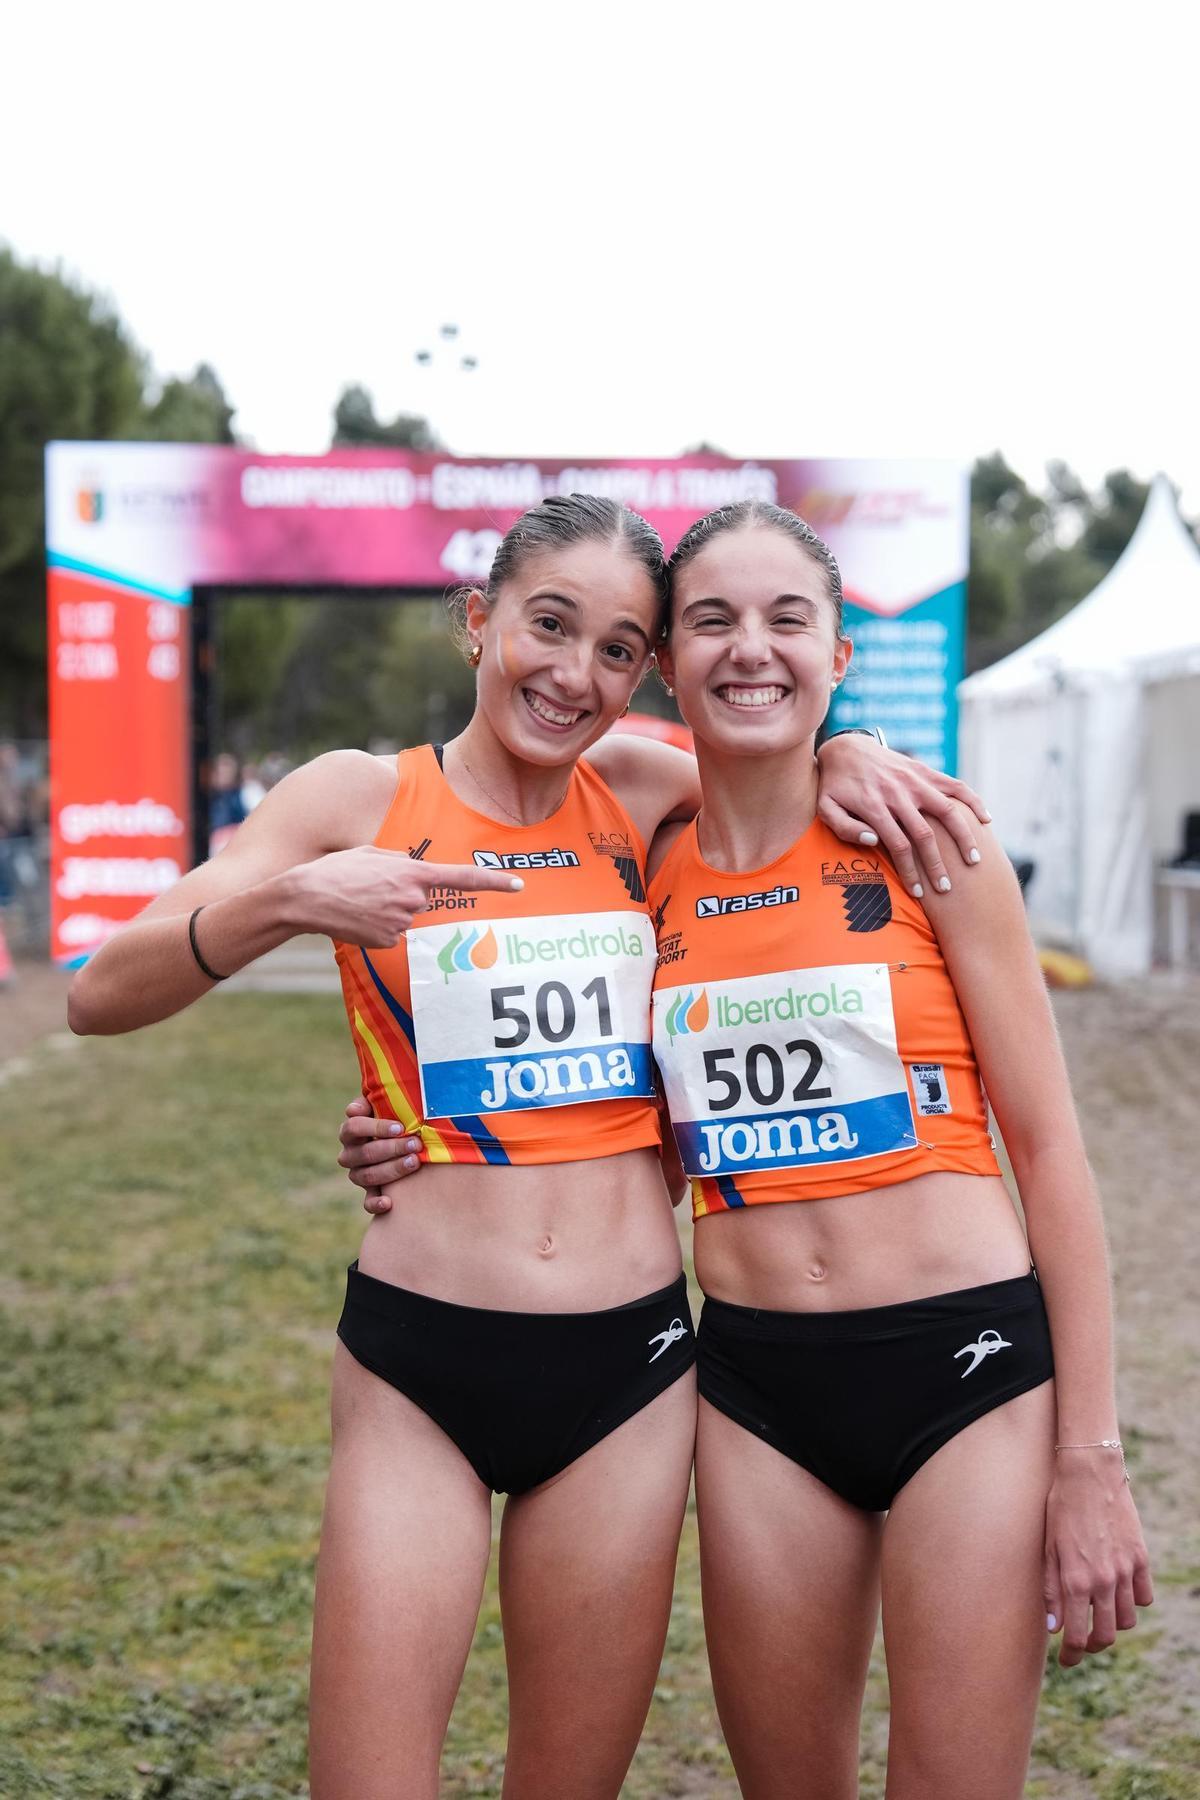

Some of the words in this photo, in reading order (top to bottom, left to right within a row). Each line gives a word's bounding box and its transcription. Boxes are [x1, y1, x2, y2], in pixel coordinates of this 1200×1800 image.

[588, 832, 629, 846] FACV
[502, 849, 579, 868] rasán
[821, 859, 880, 875] FACV
[718, 887, 798, 914] rasán
[506, 927, 643, 966] Iberdrola
[490, 976, 613, 1049] 501
[716, 982, 864, 1028] Iberdrola
[702, 1038, 832, 1112] 502
